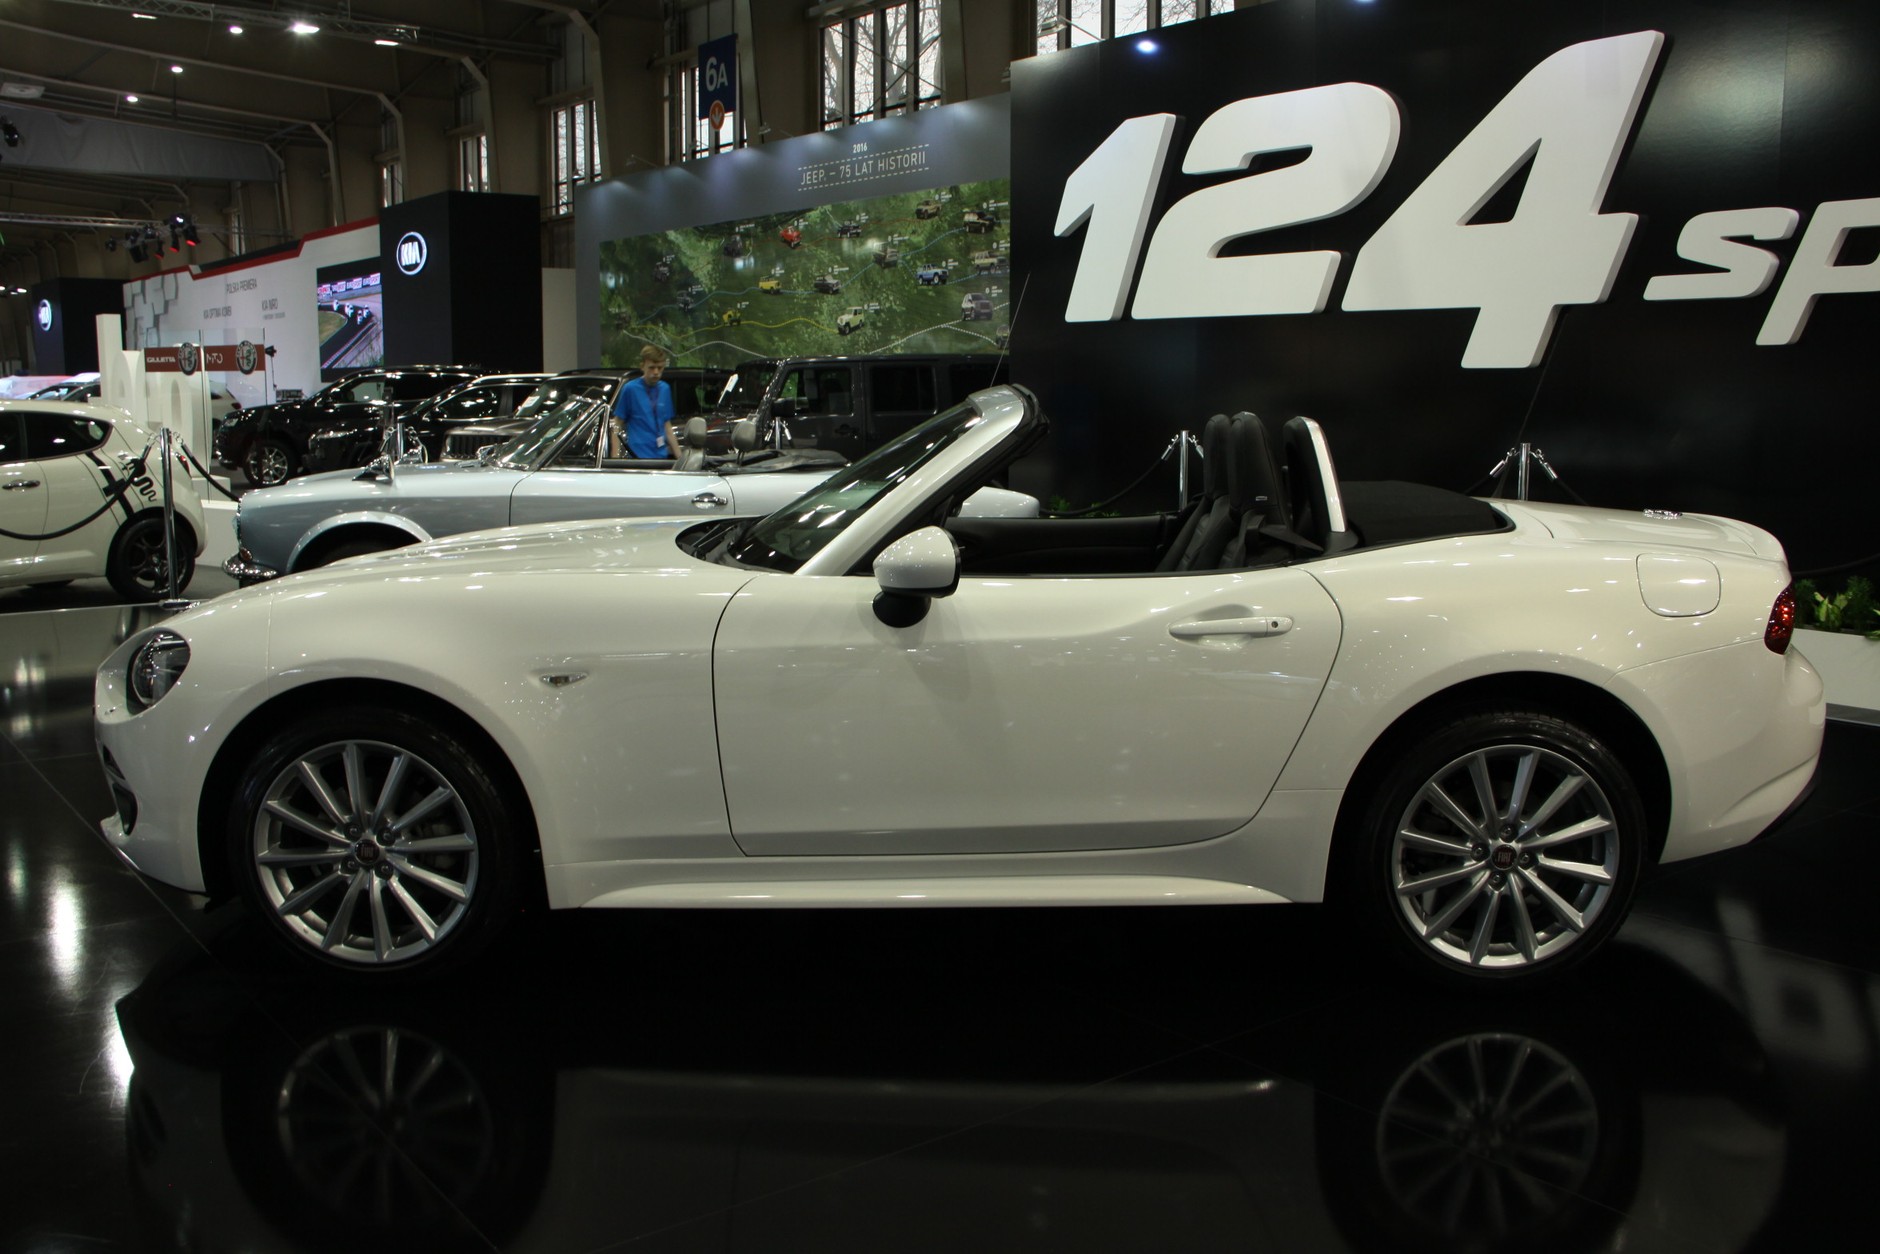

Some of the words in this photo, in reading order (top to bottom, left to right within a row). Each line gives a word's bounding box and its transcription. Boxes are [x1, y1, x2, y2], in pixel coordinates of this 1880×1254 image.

[705, 56, 728, 91] 6A
[852, 142, 868, 153] 2016
[840, 164, 851, 178] 75
[855, 160, 874, 176] LAT
[878, 151, 926, 172] HISTORII
[1054, 29, 1664, 370] 124
[1643, 196, 1880, 346] sp
[401, 241, 420, 266] KIA
[1497, 851, 1512, 863] FIAT
